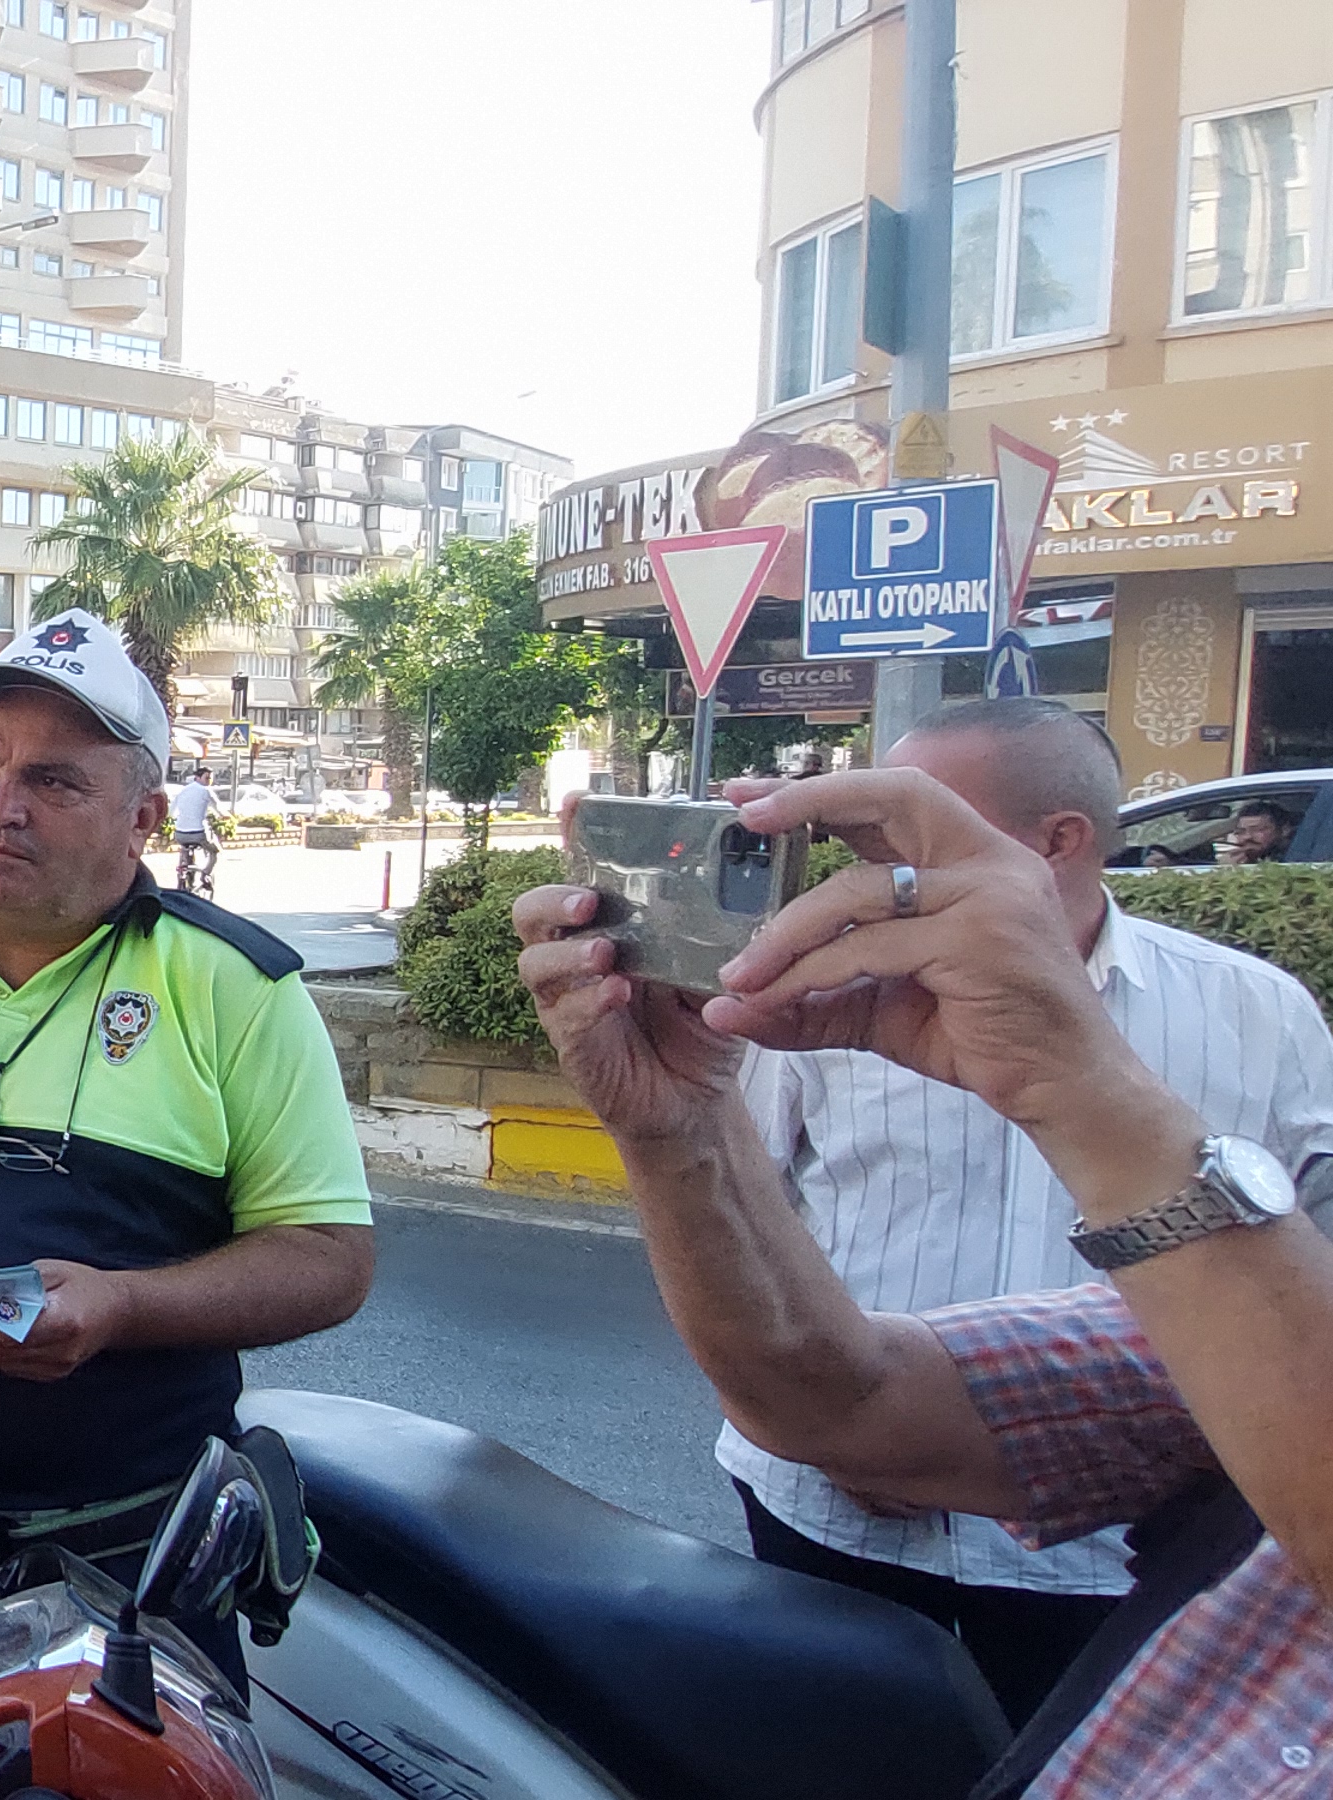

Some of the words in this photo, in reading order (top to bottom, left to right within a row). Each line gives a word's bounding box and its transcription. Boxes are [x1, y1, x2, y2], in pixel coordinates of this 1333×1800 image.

[1168, 442, 1311, 472] RESORT
[870, 506, 929, 569] P
[585, 562, 615, 590] FAB.
[810, 587, 872, 623] KATLI
[877, 578, 989, 619] OTOPARK
